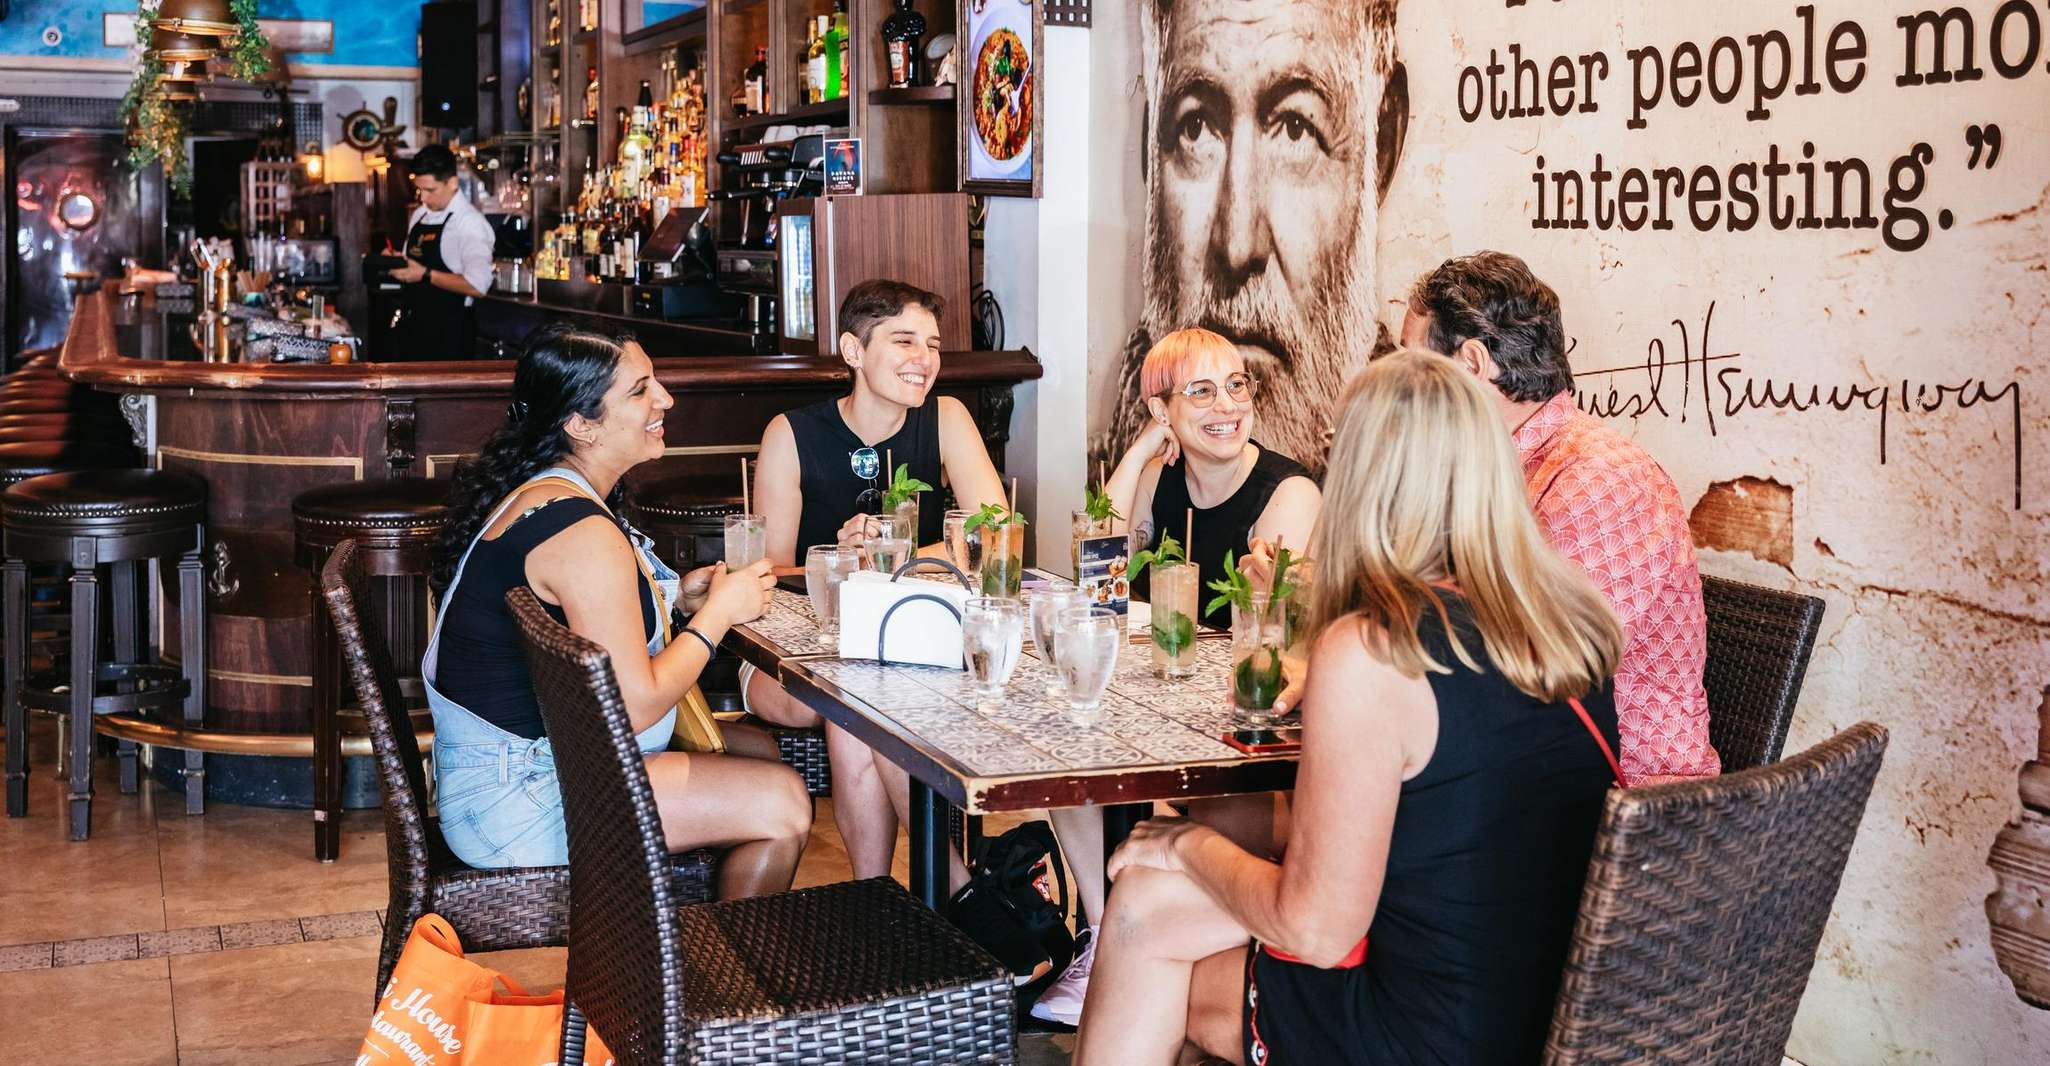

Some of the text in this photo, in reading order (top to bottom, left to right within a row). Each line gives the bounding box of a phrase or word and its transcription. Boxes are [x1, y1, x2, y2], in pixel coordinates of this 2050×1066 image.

[1457, 0, 2050, 130] other people mo
[1671, 300, 2022, 511] Hemingway
[390, 987, 462, 1055] House
